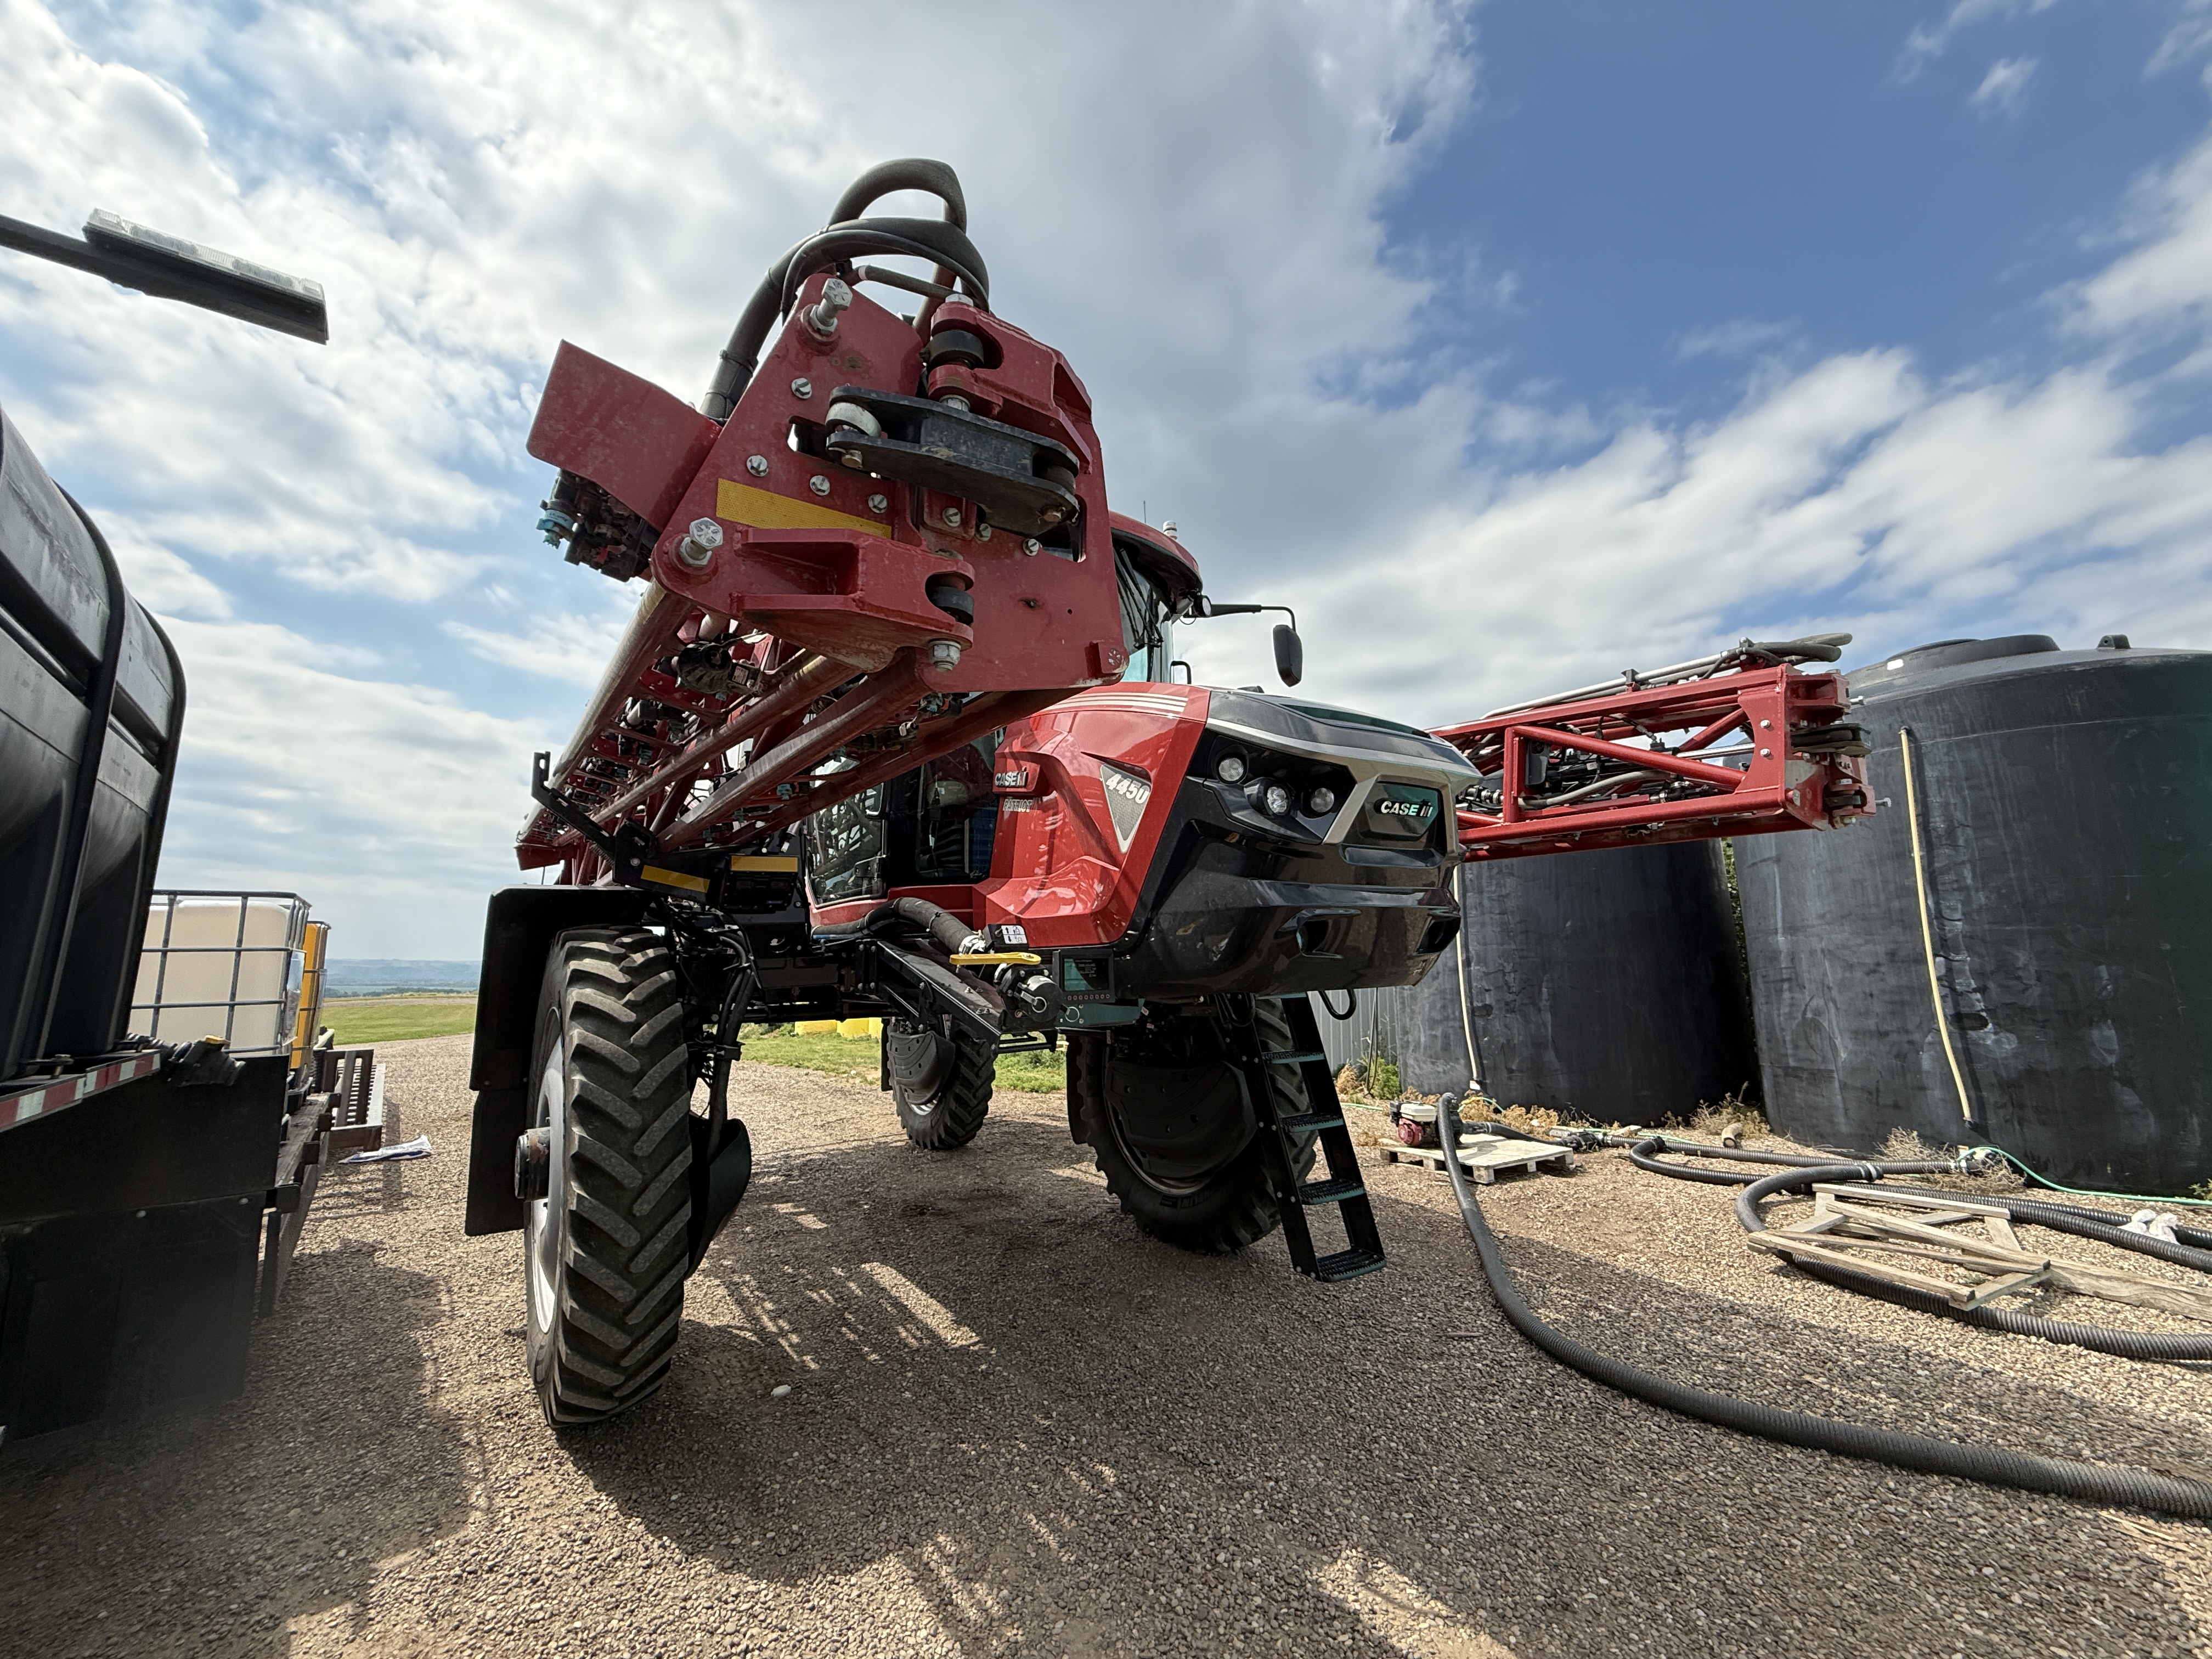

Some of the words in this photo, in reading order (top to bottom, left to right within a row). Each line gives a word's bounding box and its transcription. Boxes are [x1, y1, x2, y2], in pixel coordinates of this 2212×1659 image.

[995, 771, 1018, 786] CASE
[1105, 773, 1150, 804] 4450
[1003, 799, 1033, 812] PATRIOT
[1381, 801, 1419, 816] CASE
